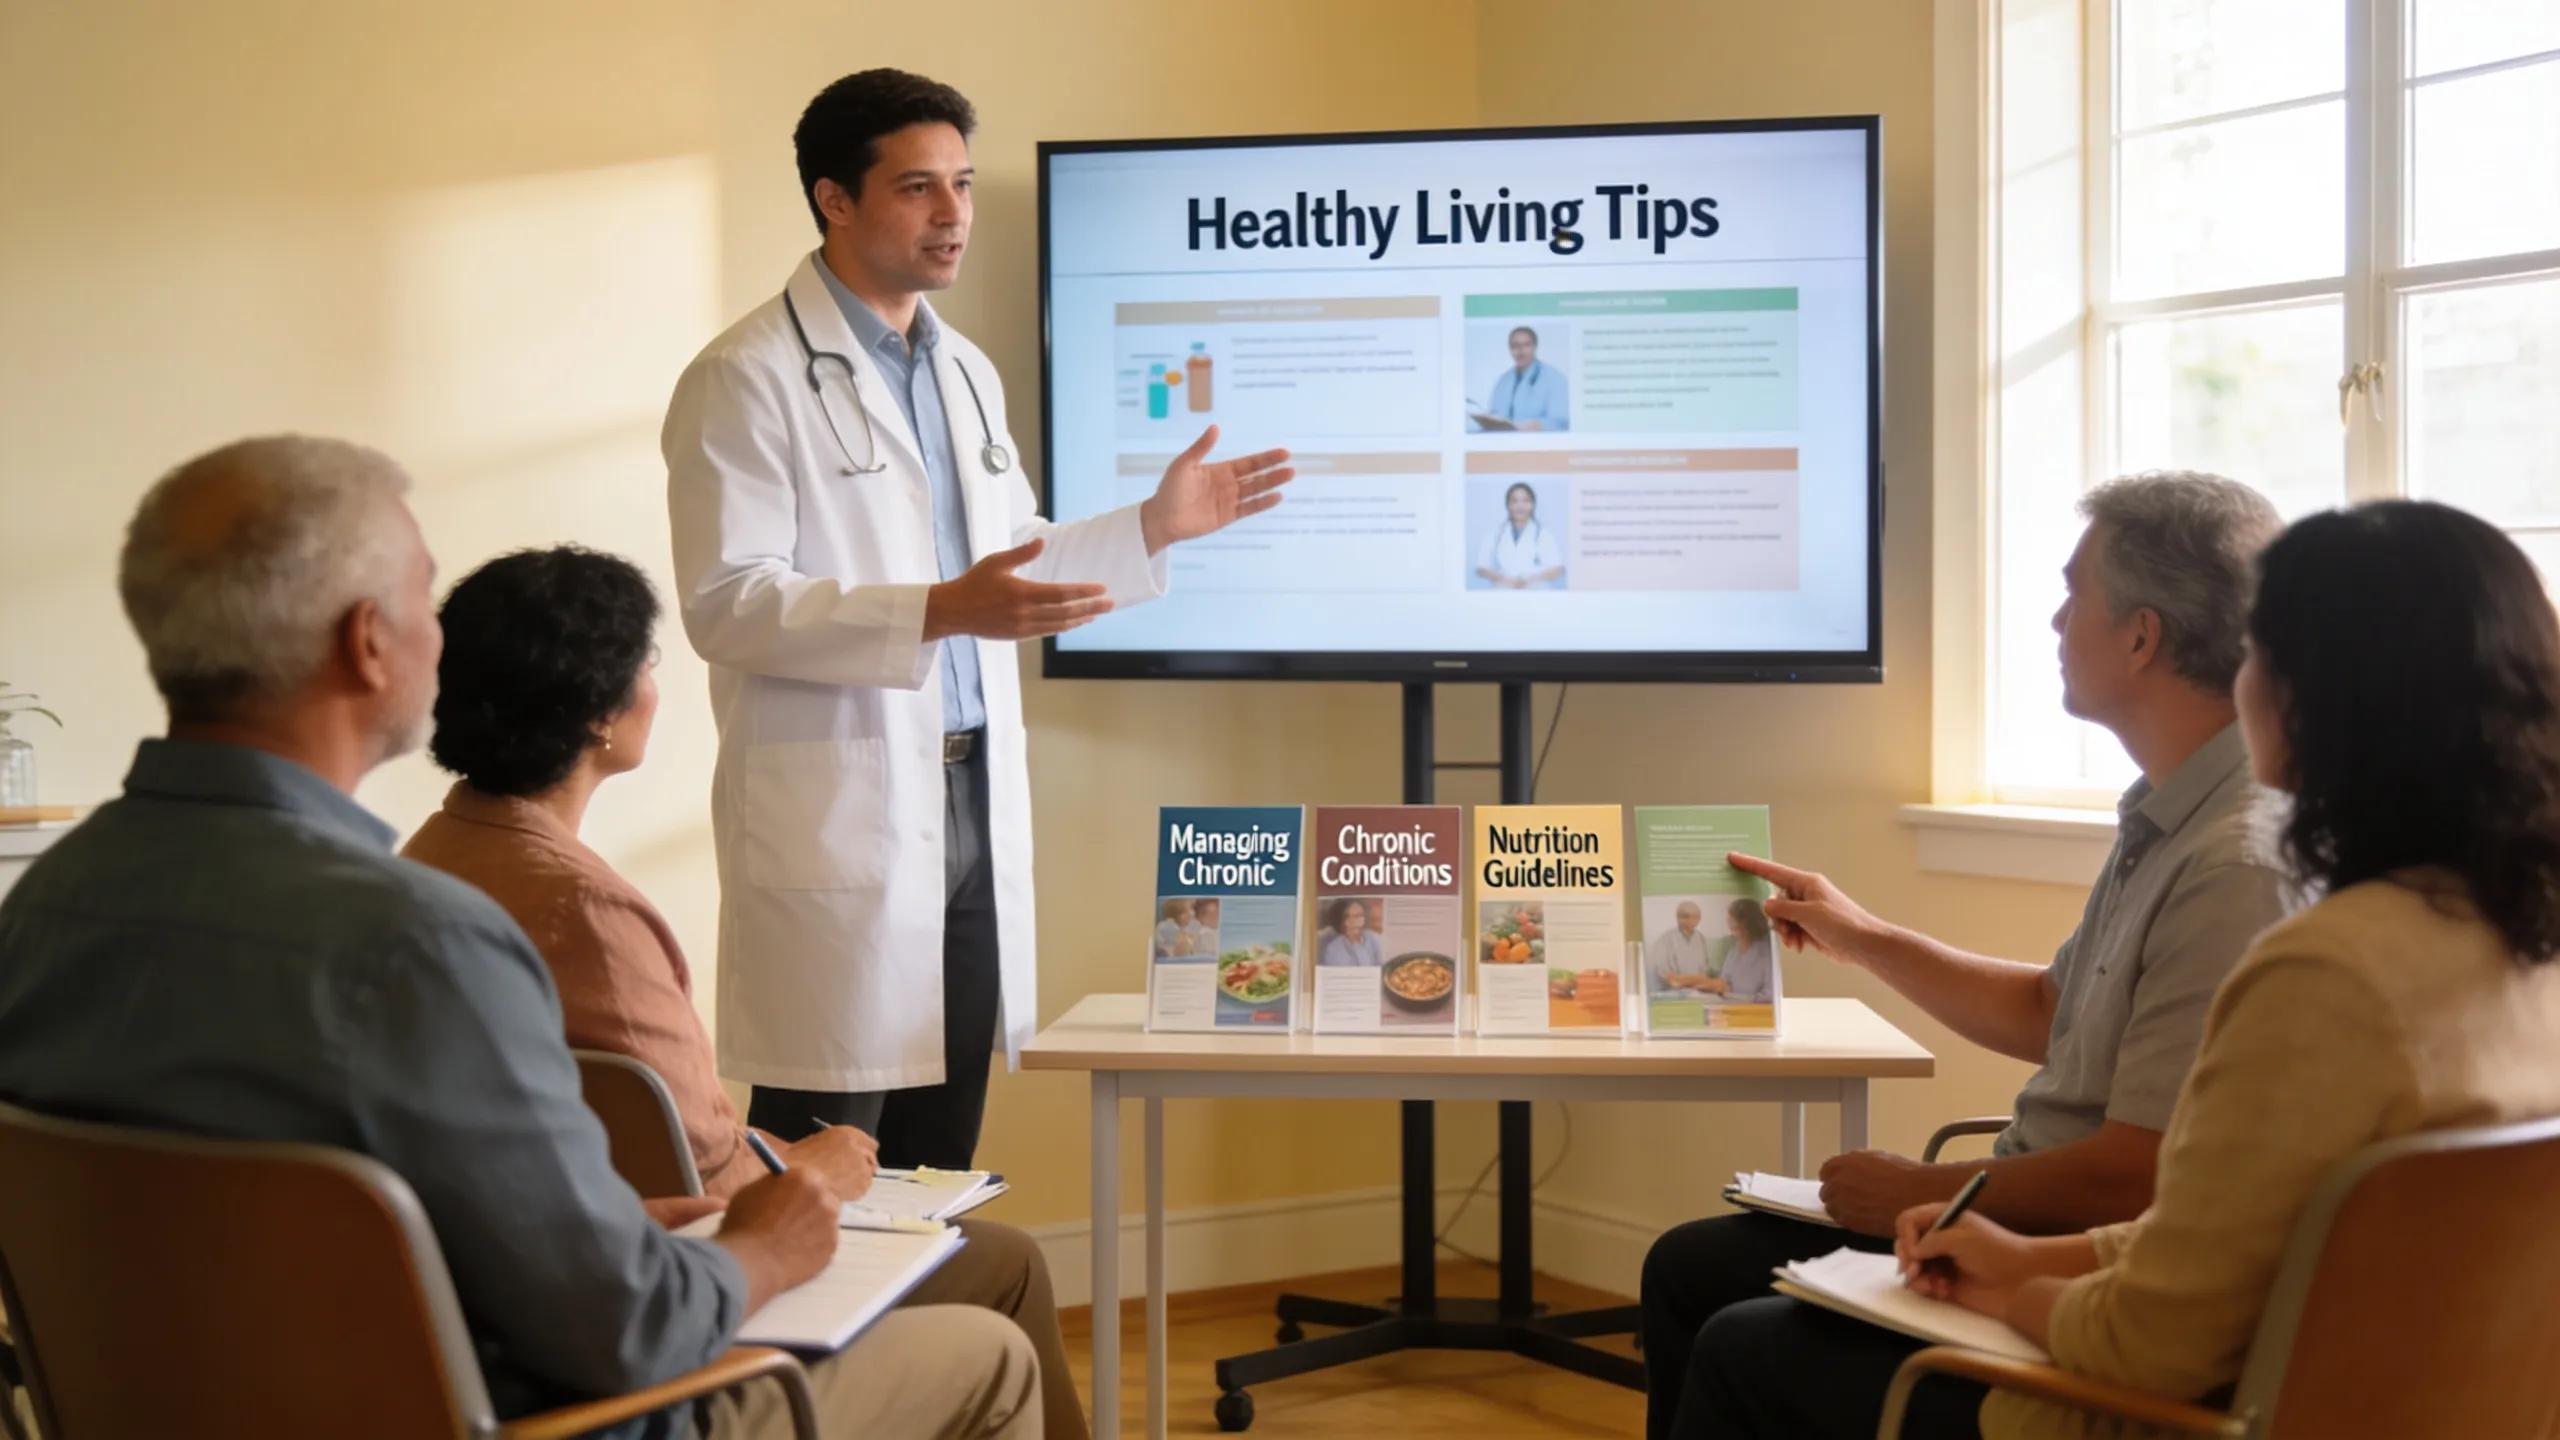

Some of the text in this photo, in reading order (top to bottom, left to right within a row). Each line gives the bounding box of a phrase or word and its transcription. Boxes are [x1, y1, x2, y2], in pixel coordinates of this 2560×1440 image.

[1187, 183, 1720, 261] Healthy Living Tips
[1170, 823, 1290, 863] Managing
[1338, 824, 1436, 854] Chronic
[1489, 824, 1599, 854] Nutrition
[1178, 856, 1275, 886] Chronic
[1321, 856, 1453, 886] Conditions
[1483, 858, 1614, 888] Guidelines
